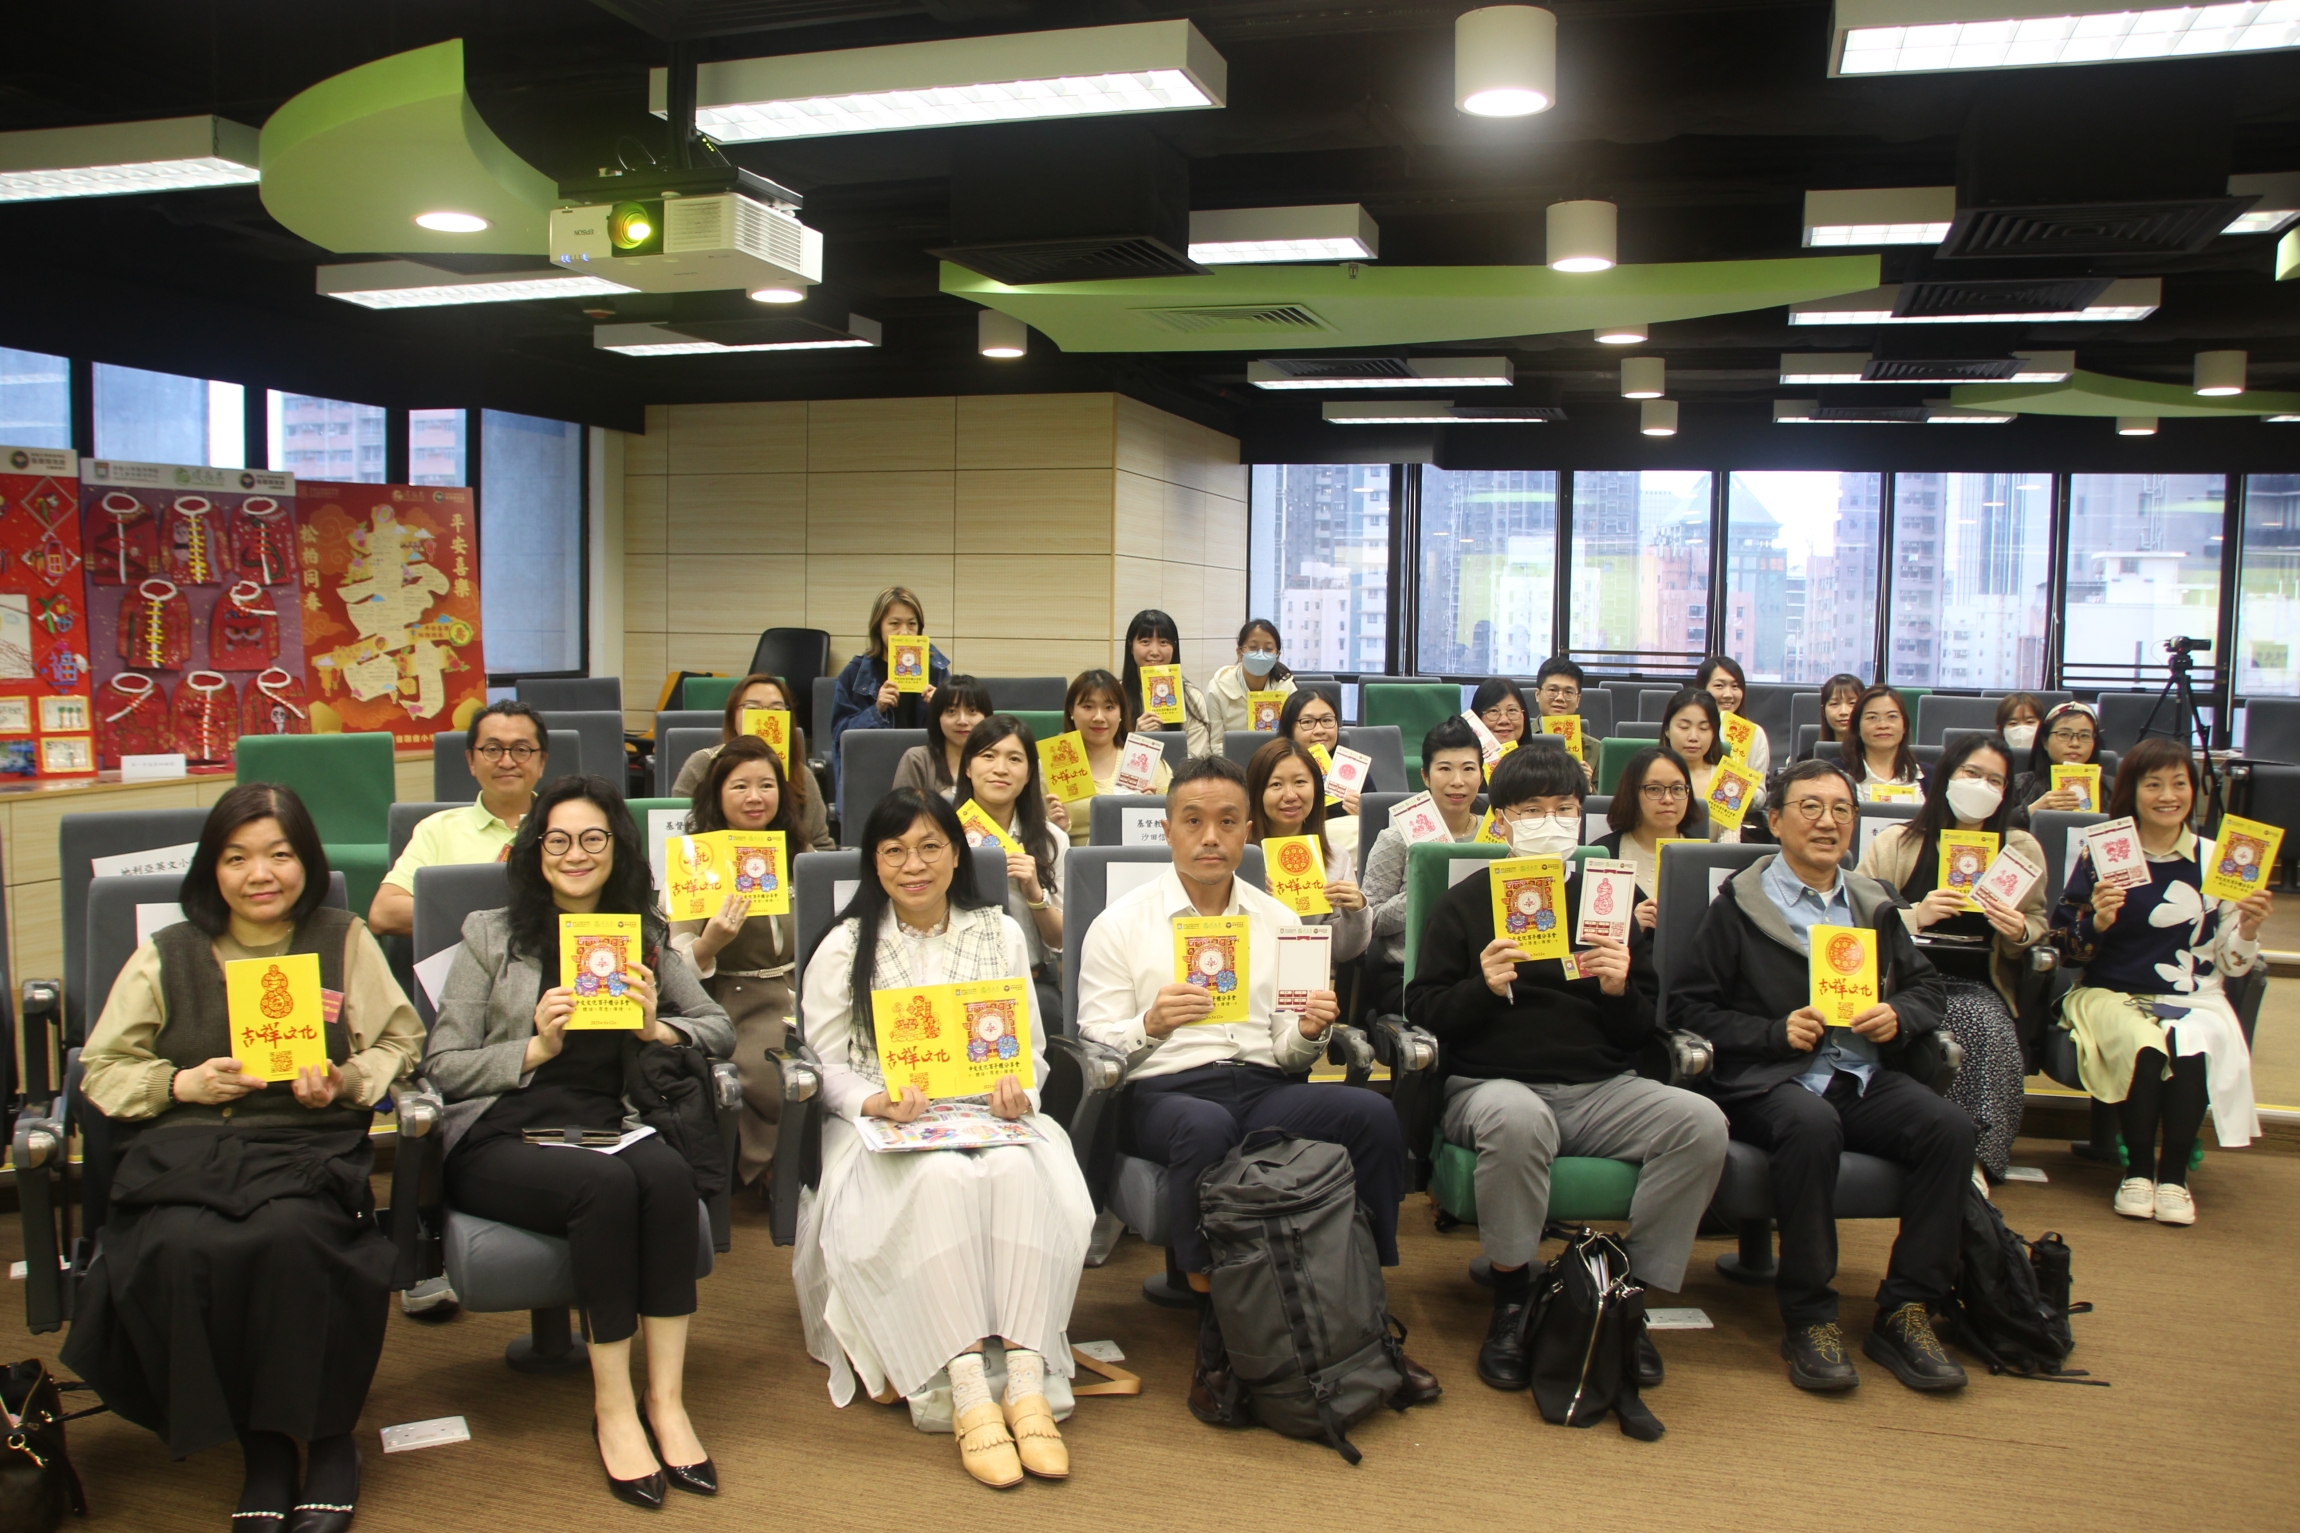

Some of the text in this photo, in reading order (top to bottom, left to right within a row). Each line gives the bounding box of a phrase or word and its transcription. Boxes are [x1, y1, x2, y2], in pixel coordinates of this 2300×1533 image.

[573, 228, 595, 236] EPSON
[450, 513, 471, 598] 平安喜樂
[299, 524, 323, 611] 松柏同春
[1049, 768, 1088, 786] 吉祥文化
[672, 879, 722, 898] 吉祥文化
[1275, 877, 1324, 896] 吉祥文化
[1818, 977, 1873, 1000] 吉祥文化
[240, 1021, 318, 1050] 吉祥文化
[885, 1045, 951, 1071] 吉祥文化
